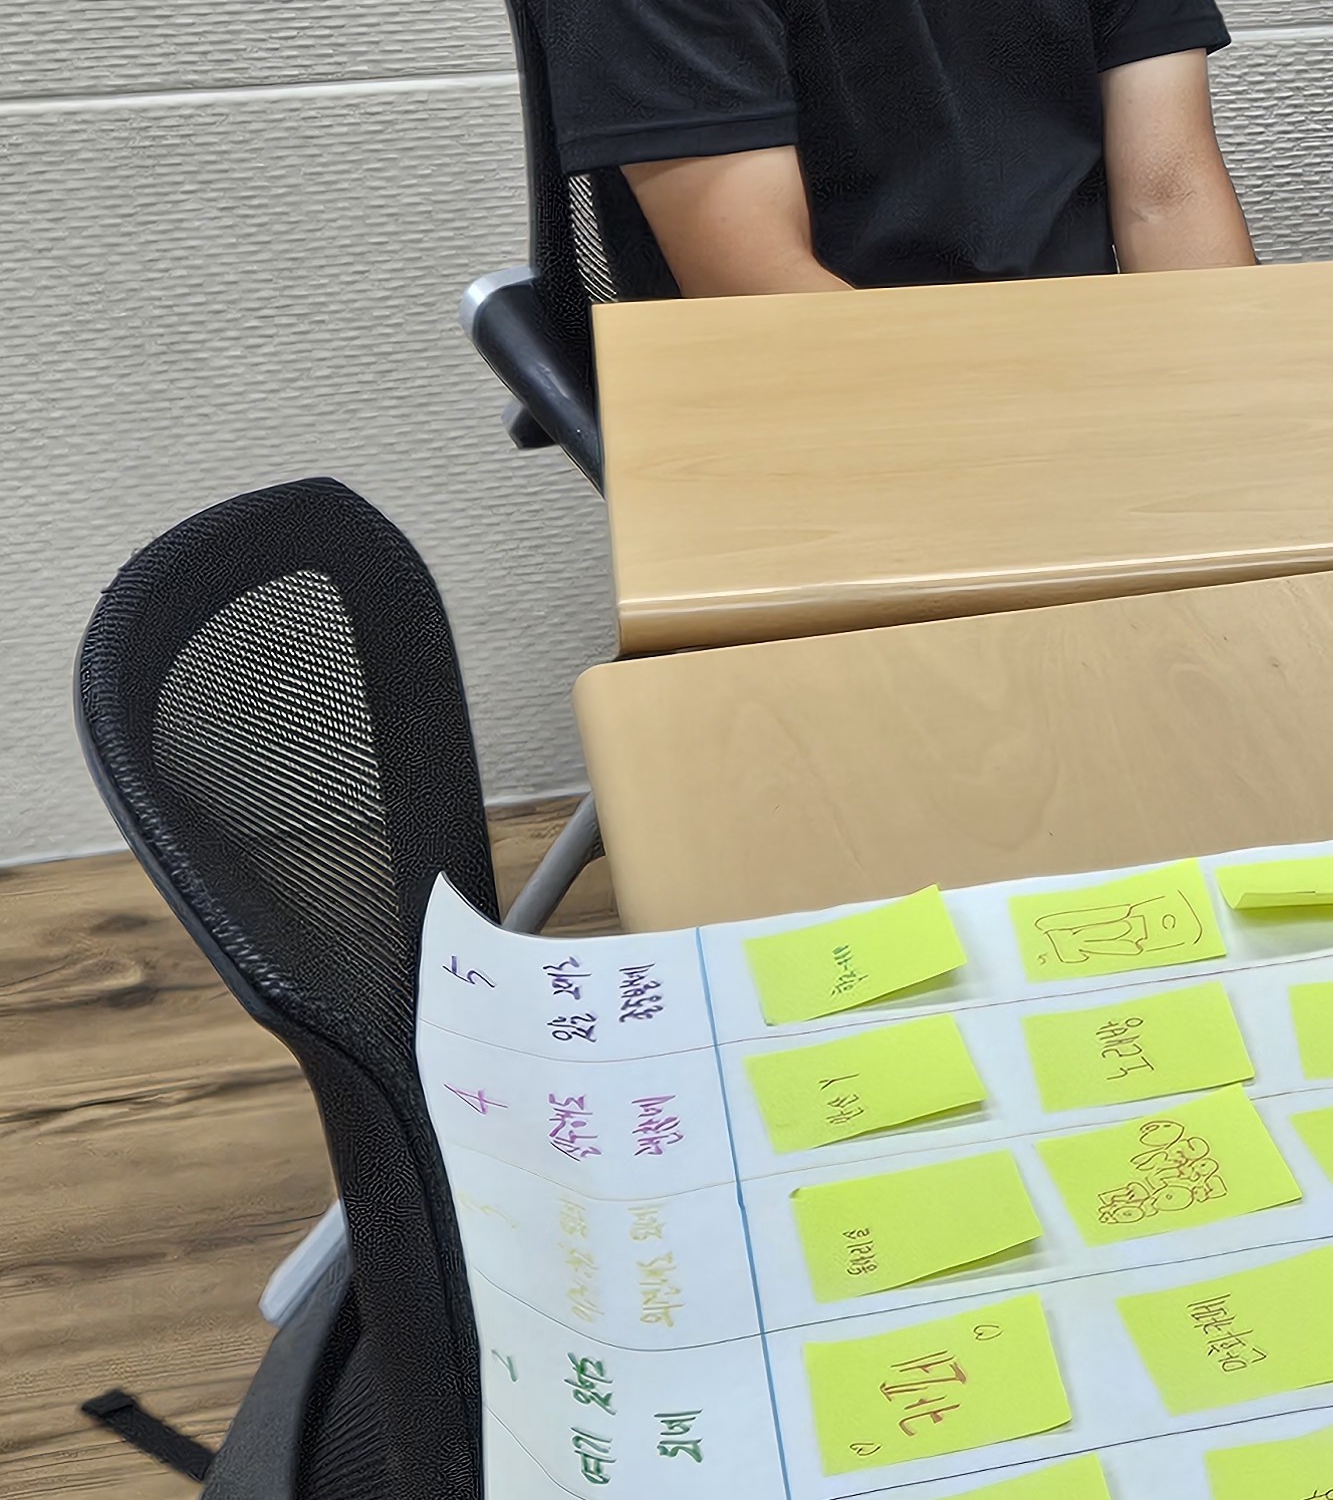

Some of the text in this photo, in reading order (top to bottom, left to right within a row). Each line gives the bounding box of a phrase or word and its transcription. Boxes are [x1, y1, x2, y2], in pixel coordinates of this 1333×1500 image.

[443, 956, 495, 988] 5
[1096, 1018, 1154, 1080] 노래방
[444, 1084, 508, 1114] 4
[819, 1074, 859, 1090] Y
[549, 1094, 600, 1161] 실수해도
[1187, 1294, 1266, 1372] 만화카페
[880, 1350, 966, 1436] 카페
[572, 1427, 616, 1484] 여기
